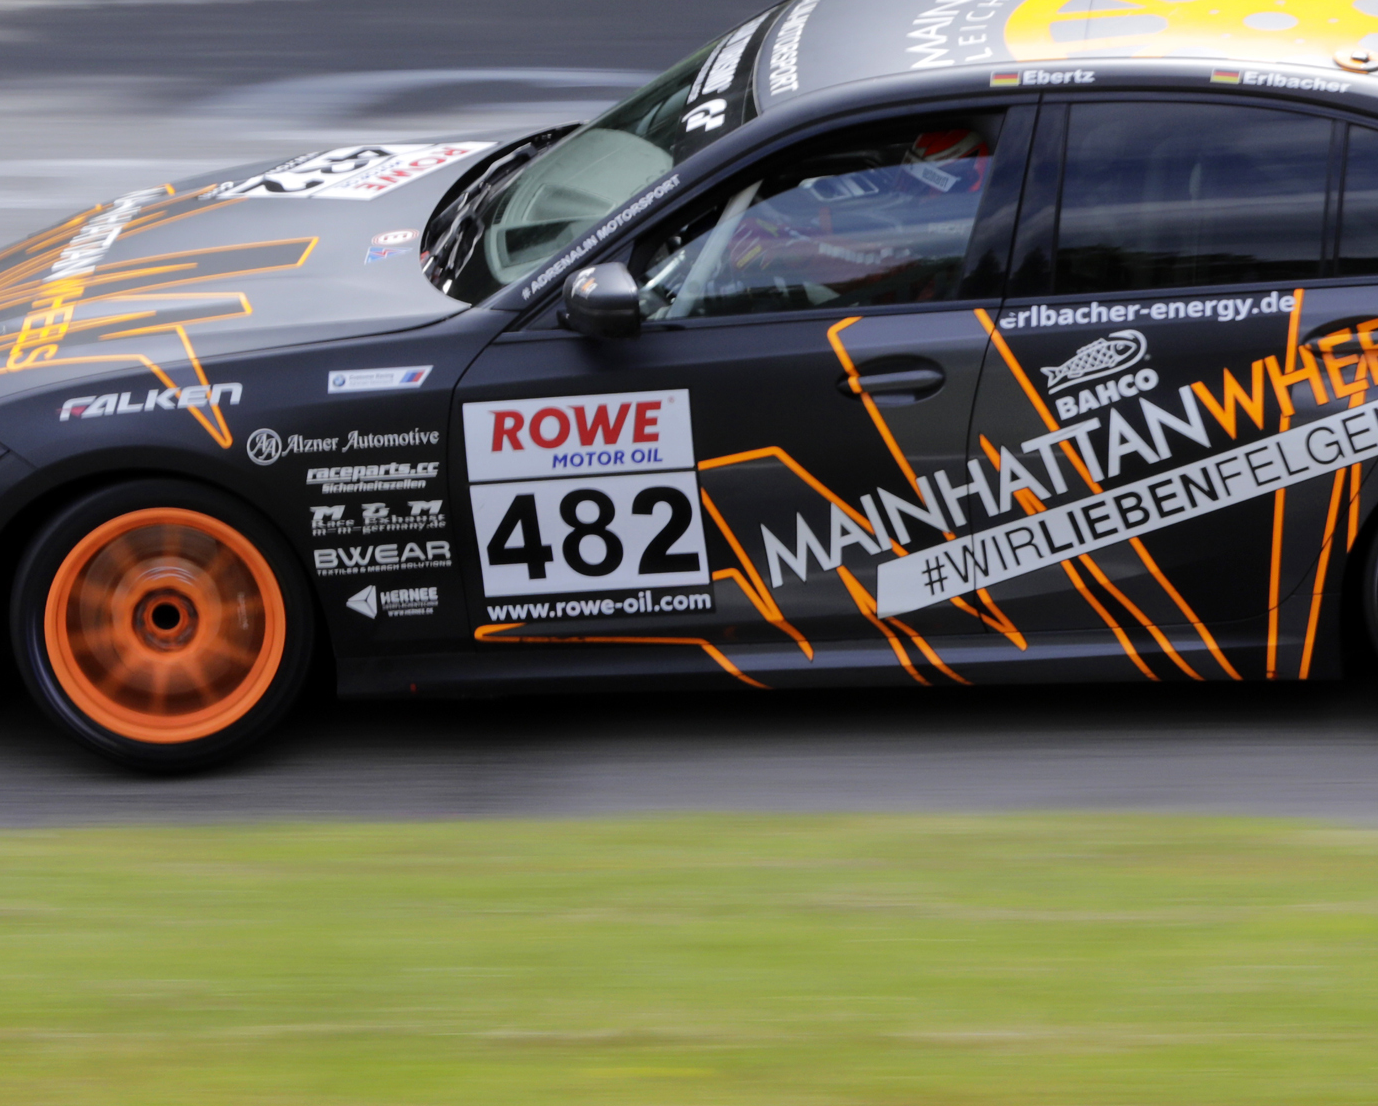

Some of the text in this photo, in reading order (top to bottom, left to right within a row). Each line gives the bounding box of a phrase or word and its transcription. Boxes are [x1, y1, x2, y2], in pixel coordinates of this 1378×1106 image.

[1022, 68, 1096, 86] Ebertz
[1242, 70, 1352, 94] Erlbacher
[530, 234, 599, 295] ADRENALIN
[596, 173, 681, 242] MOTORSPORT
[999, 291, 1297, 330] erlbacher-energy.de
[1055, 368, 1159, 421] BAHCO
[488, 400, 663, 452] ROWE
[281, 427, 440, 457] Alzner Automotive
[306, 462, 440, 483] raceparts.cc
[552, 448, 663, 469] MOTOR OIL
[322, 479, 427, 494] Sicherheitszellen
[487, 486, 701, 580] 482
[314, 540, 451, 569] BWEAR
[380, 587, 438, 605] HERNEE
[487, 591, 712, 621] www.rowe-oil.com
